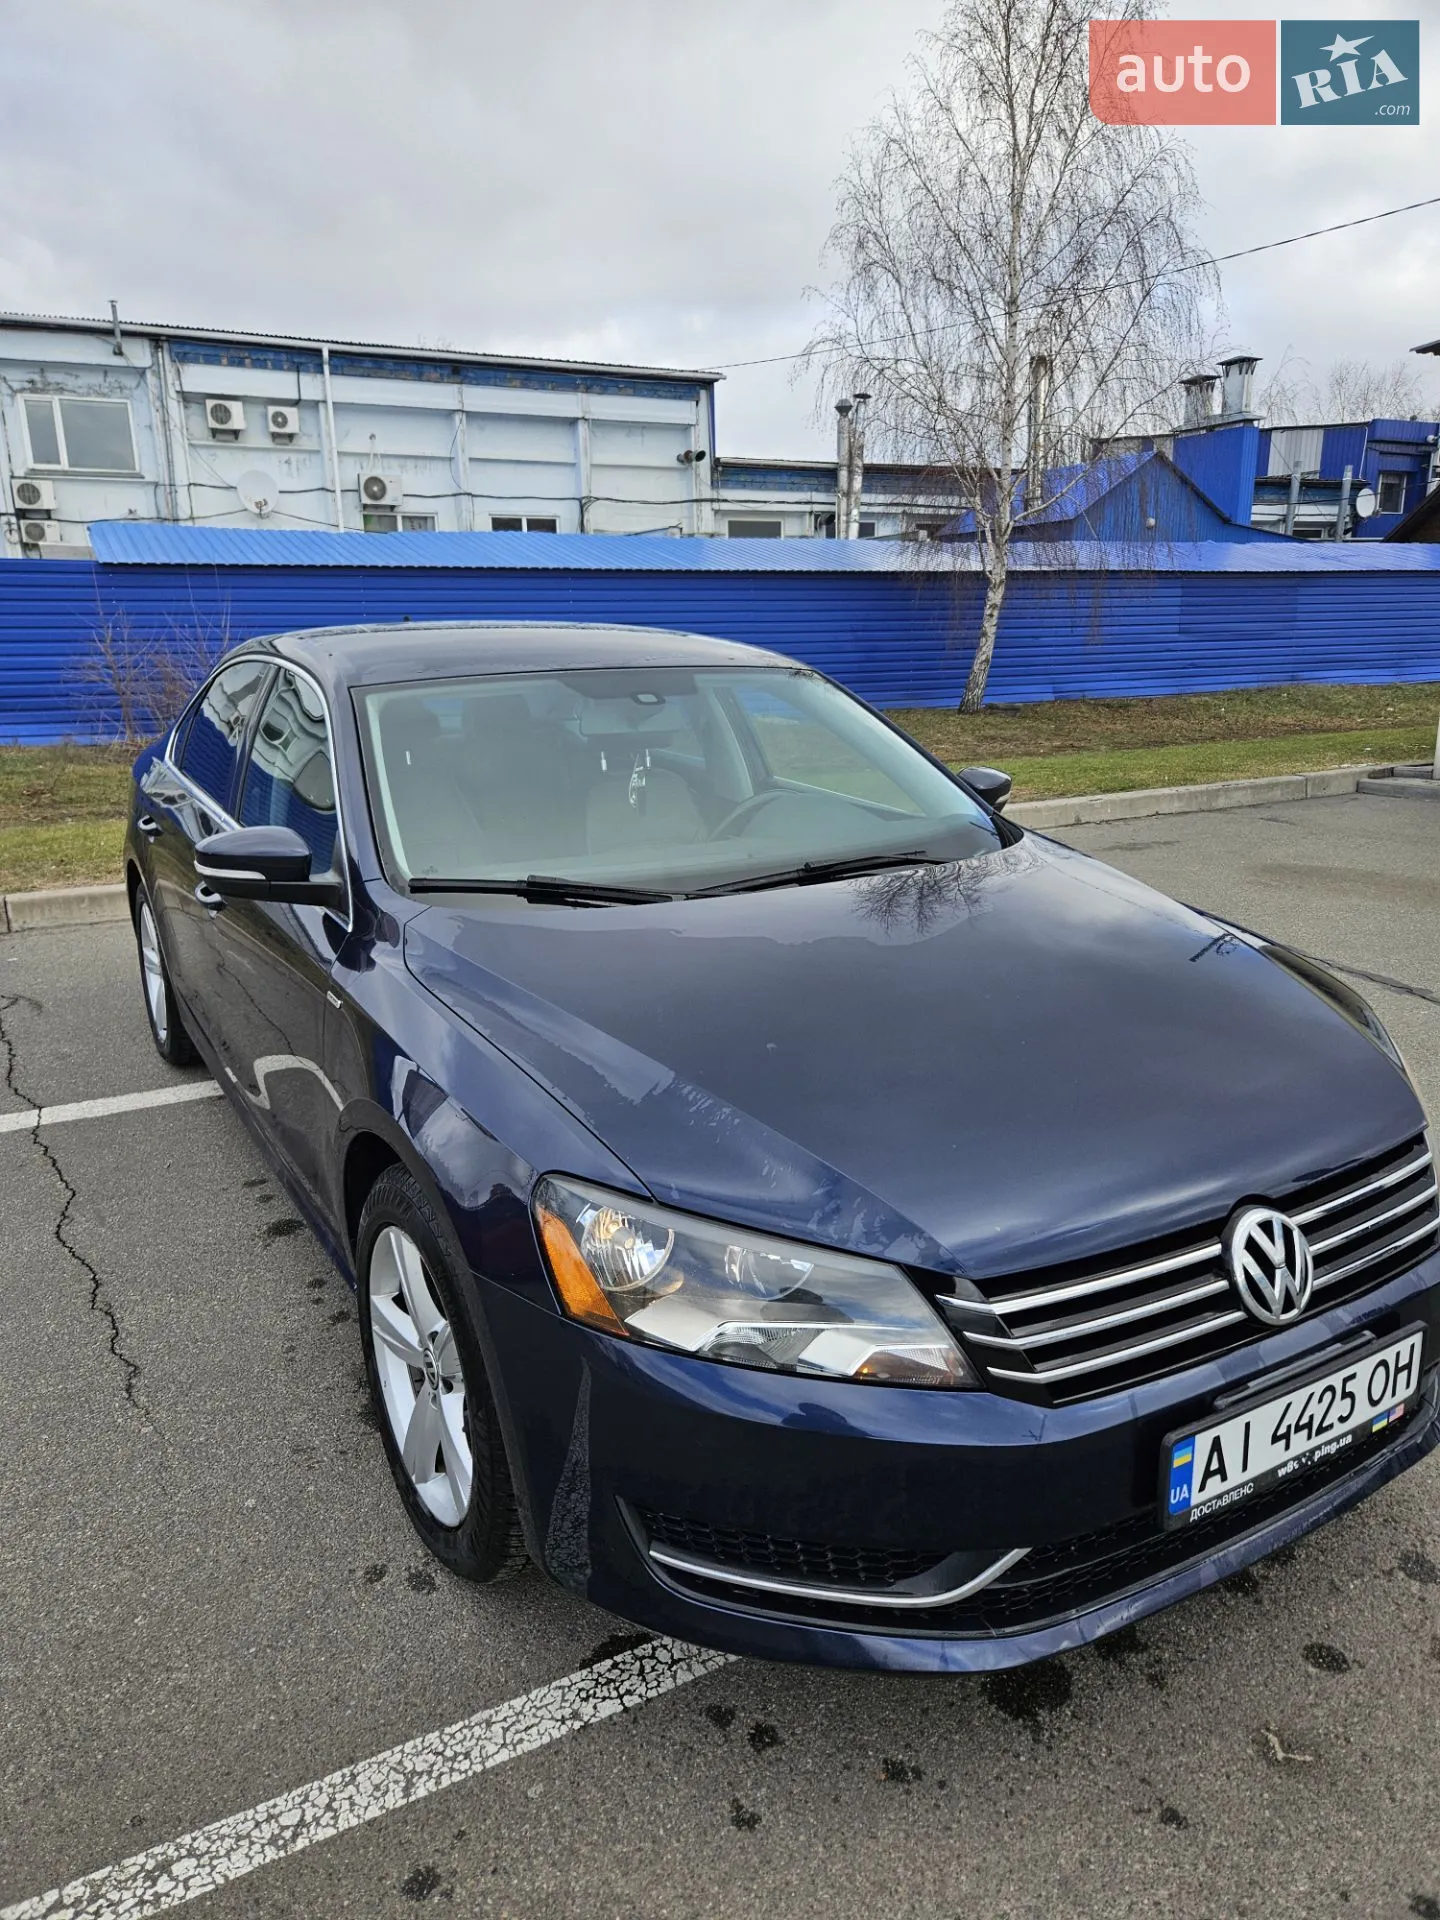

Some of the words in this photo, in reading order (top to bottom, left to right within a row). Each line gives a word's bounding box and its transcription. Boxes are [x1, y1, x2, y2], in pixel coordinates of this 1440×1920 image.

[1198, 1421, 1250, 1493] AI
[1270, 1372, 1356, 1452] 4425
[1367, 1342, 1415, 1407] OH
[1170, 1484, 1189, 1504] UA
